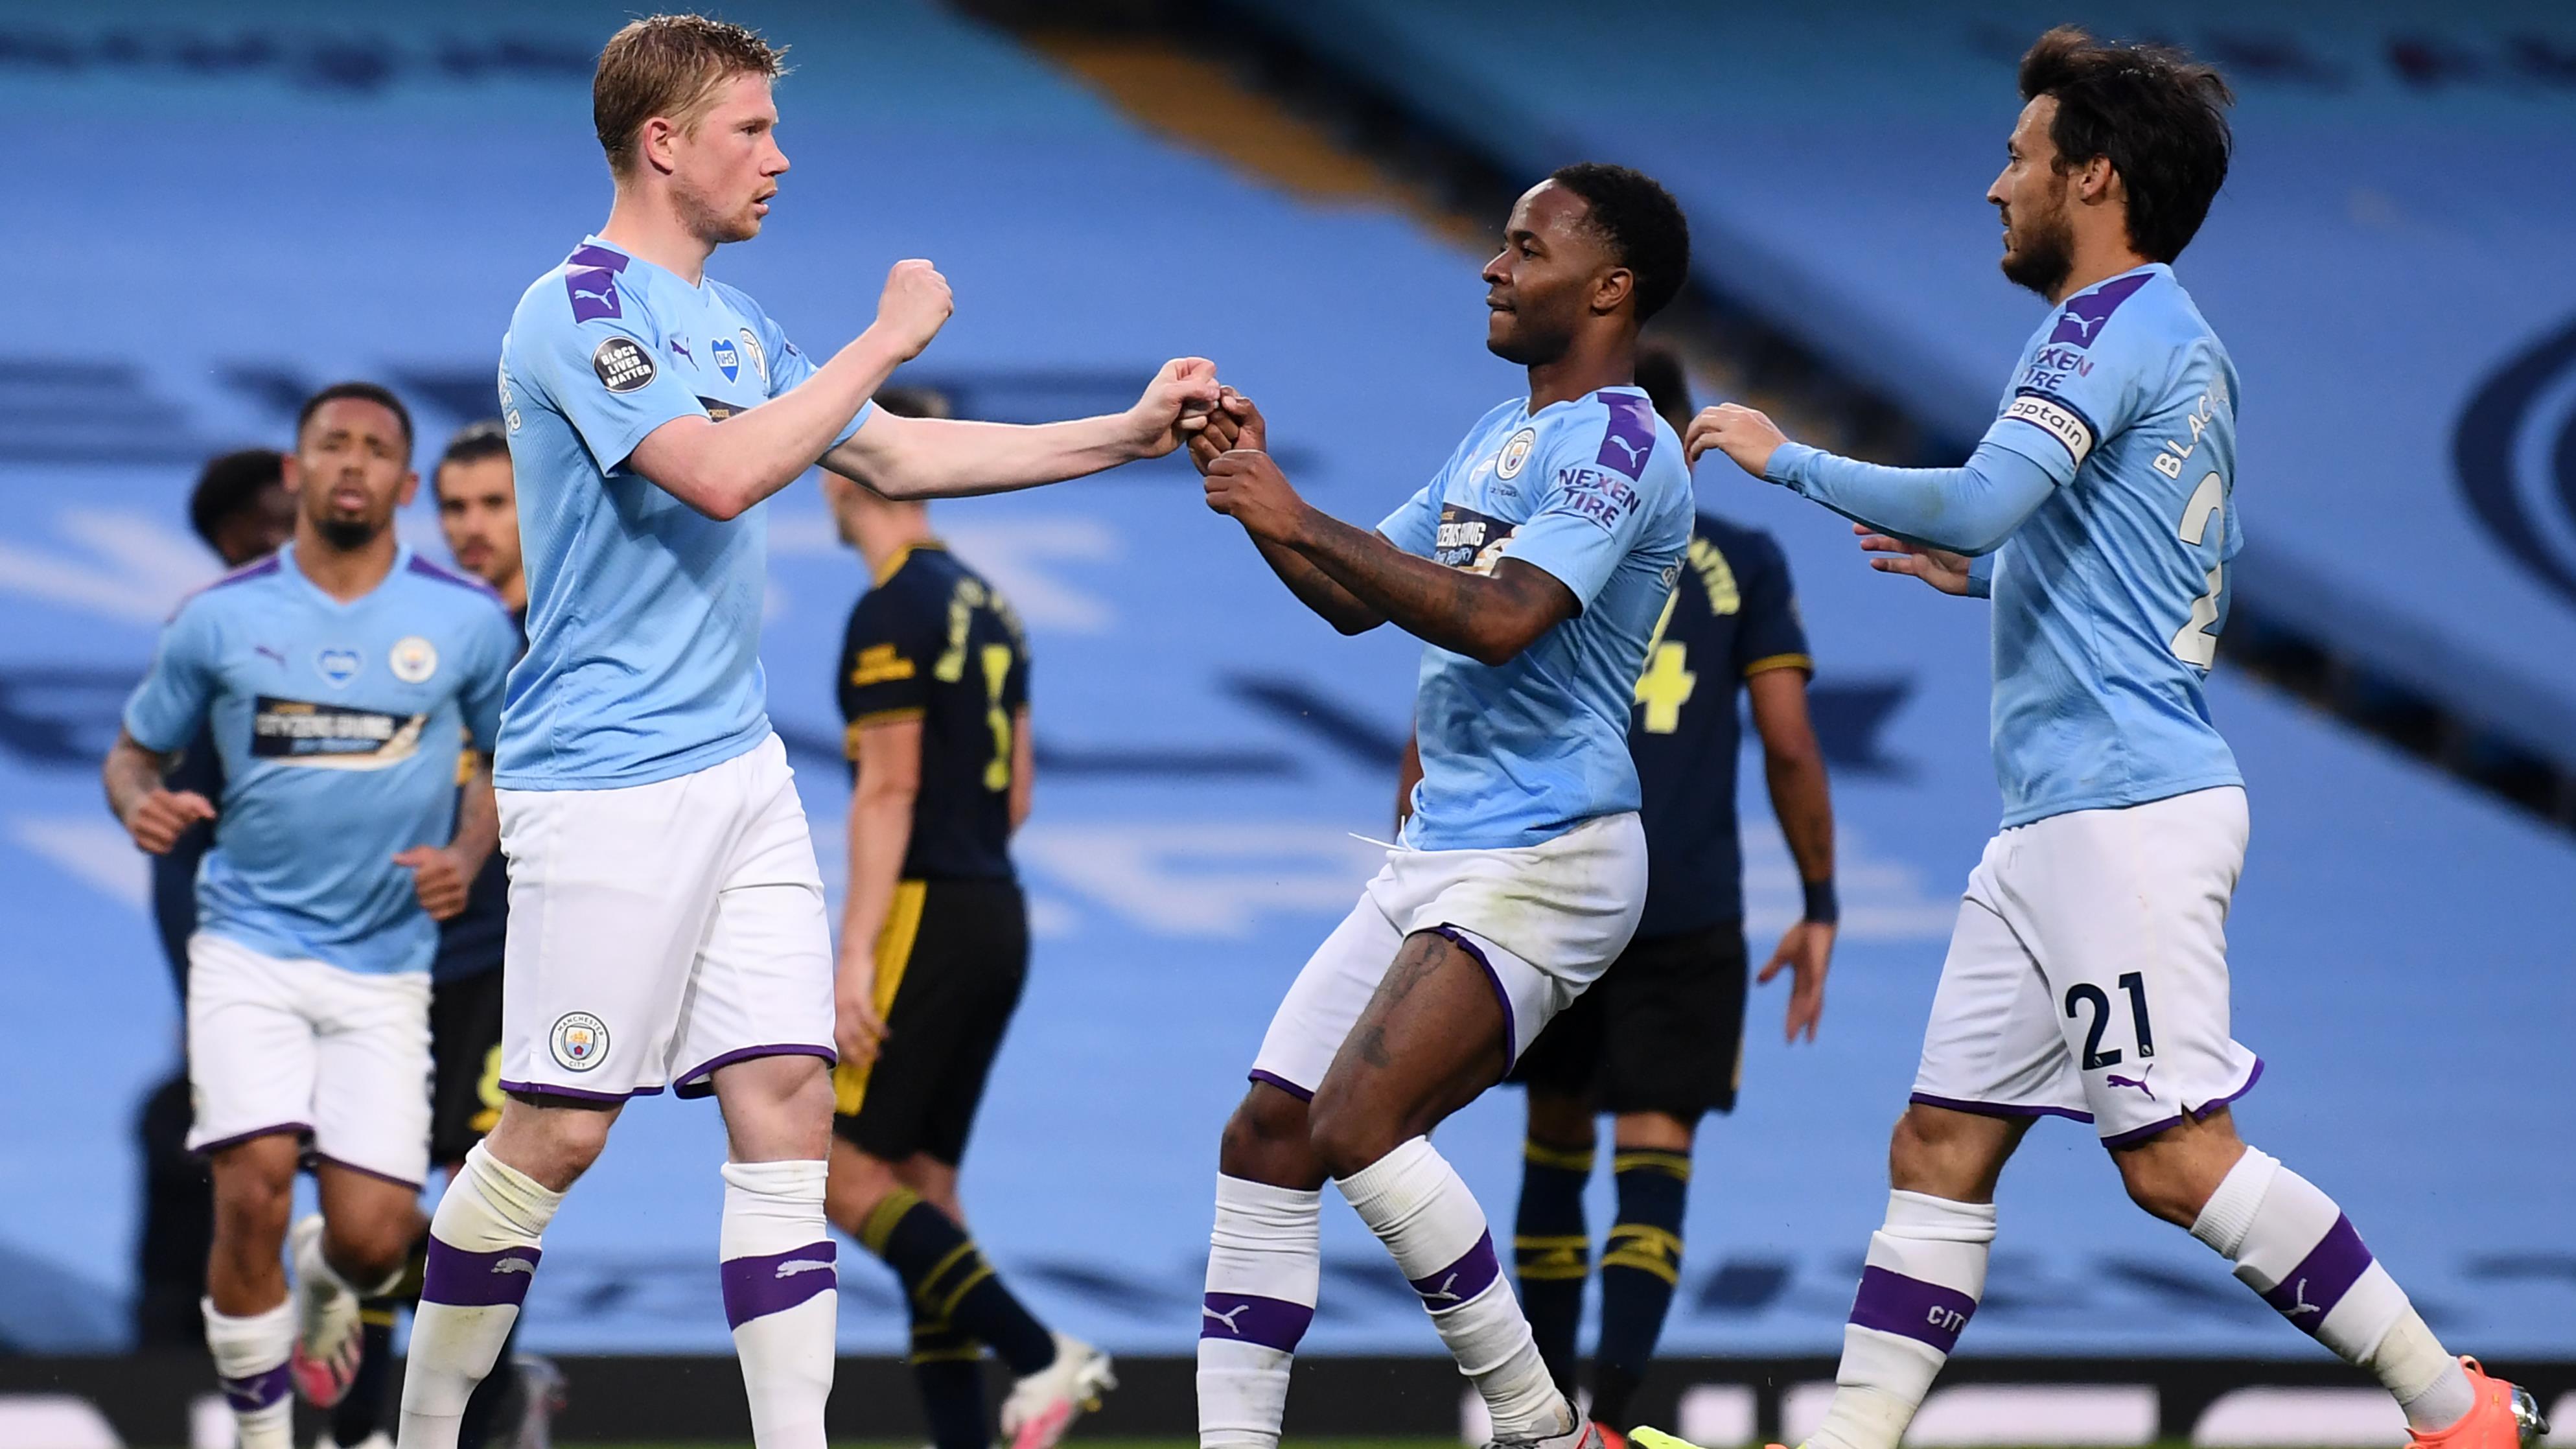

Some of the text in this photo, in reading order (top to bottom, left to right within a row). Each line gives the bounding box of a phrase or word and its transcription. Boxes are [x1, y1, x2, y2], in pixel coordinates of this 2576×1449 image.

[607, 355, 641, 375] LIVES
[717, 352, 735, 365] NHS
[2036, 348, 2095, 378] XEN
[606, 364, 652, 388] MATTER
[2022, 367, 2067, 391] IRE
[2012, 402, 2083, 446] aptain
[1559, 469, 1641, 516] NEXEN
[1562, 487, 1619, 528] TIRE
[557, 1015, 604, 1036] MANCHESTER
[2065, 971, 2155, 1071] 21
